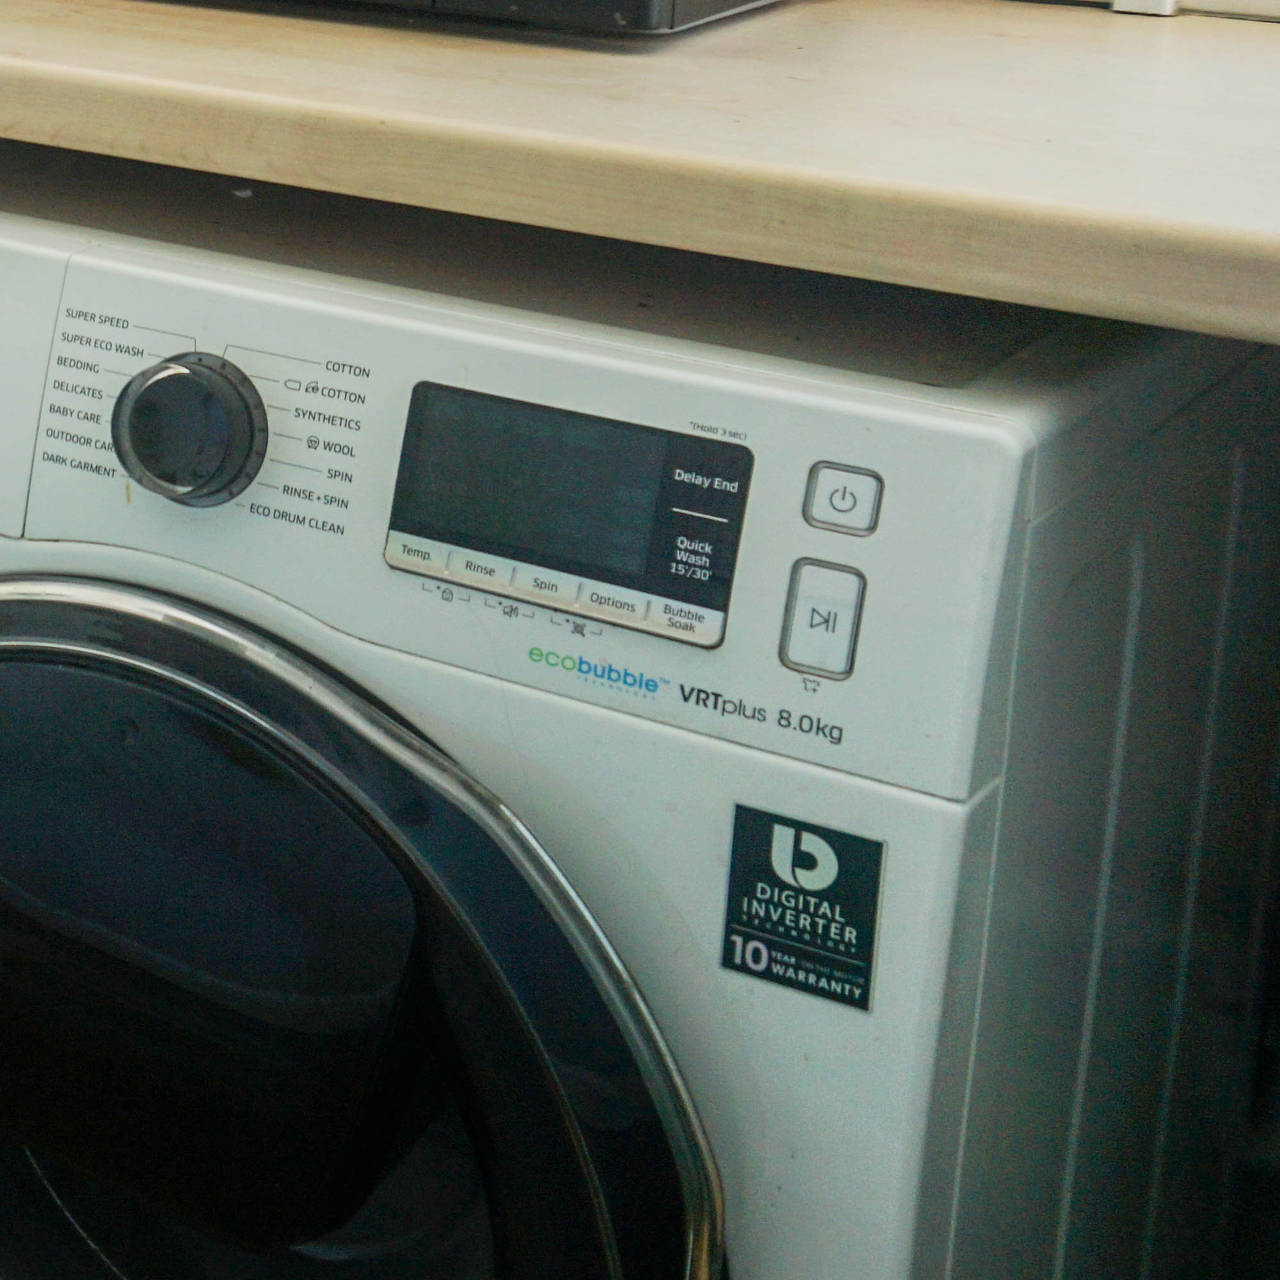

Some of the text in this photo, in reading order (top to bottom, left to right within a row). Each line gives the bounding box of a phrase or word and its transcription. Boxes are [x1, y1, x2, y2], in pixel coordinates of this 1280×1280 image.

[66, 308, 129, 329] SUPER SPEED
[61, 332, 144, 358] SUPER ECO WASH
[57, 355, 100, 374] BEDDING
[325, 361, 370, 378] COTTON
[53, 380, 103, 400] DELICATES
[321, 386, 366, 404] COTTON
[49, 403, 102, 424] BABY CARE
[295, 407, 361, 431] SYNTHETICS
[46, 428, 114, 452] OUTDOOR CAR
[323, 440, 356, 457] WOOL
[42, 451, 117, 478] DARK GARMENT
[327, 469, 354, 483] SPIN
[674, 469, 739, 493] Delay End
[283, 484, 314, 501] RINSE
[323, 495, 349, 510] SPIN
[249, 503, 345, 535] ECO DRUM CLEAN
[401, 543, 432, 562] Temp.
[677, 536, 712, 554] Quick
[465, 559, 495, 577] Rinse
[676, 549, 710, 567] Wash
[533, 577, 558, 593] Spin
[590, 592, 636, 613] Options
[663, 603, 705, 623] Bubble
[668, 617, 696, 633] Soak
[680, 683, 843, 745] VRTplus 8.0kg
[756, 882, 845, 923] DIGITAL
[743, 897, 857, 944] INVERTER
[730, 934, 769, 972] 10
[771, 951, 796, 964] YEAR
[771, 963, 862, 999] WARRANTY
